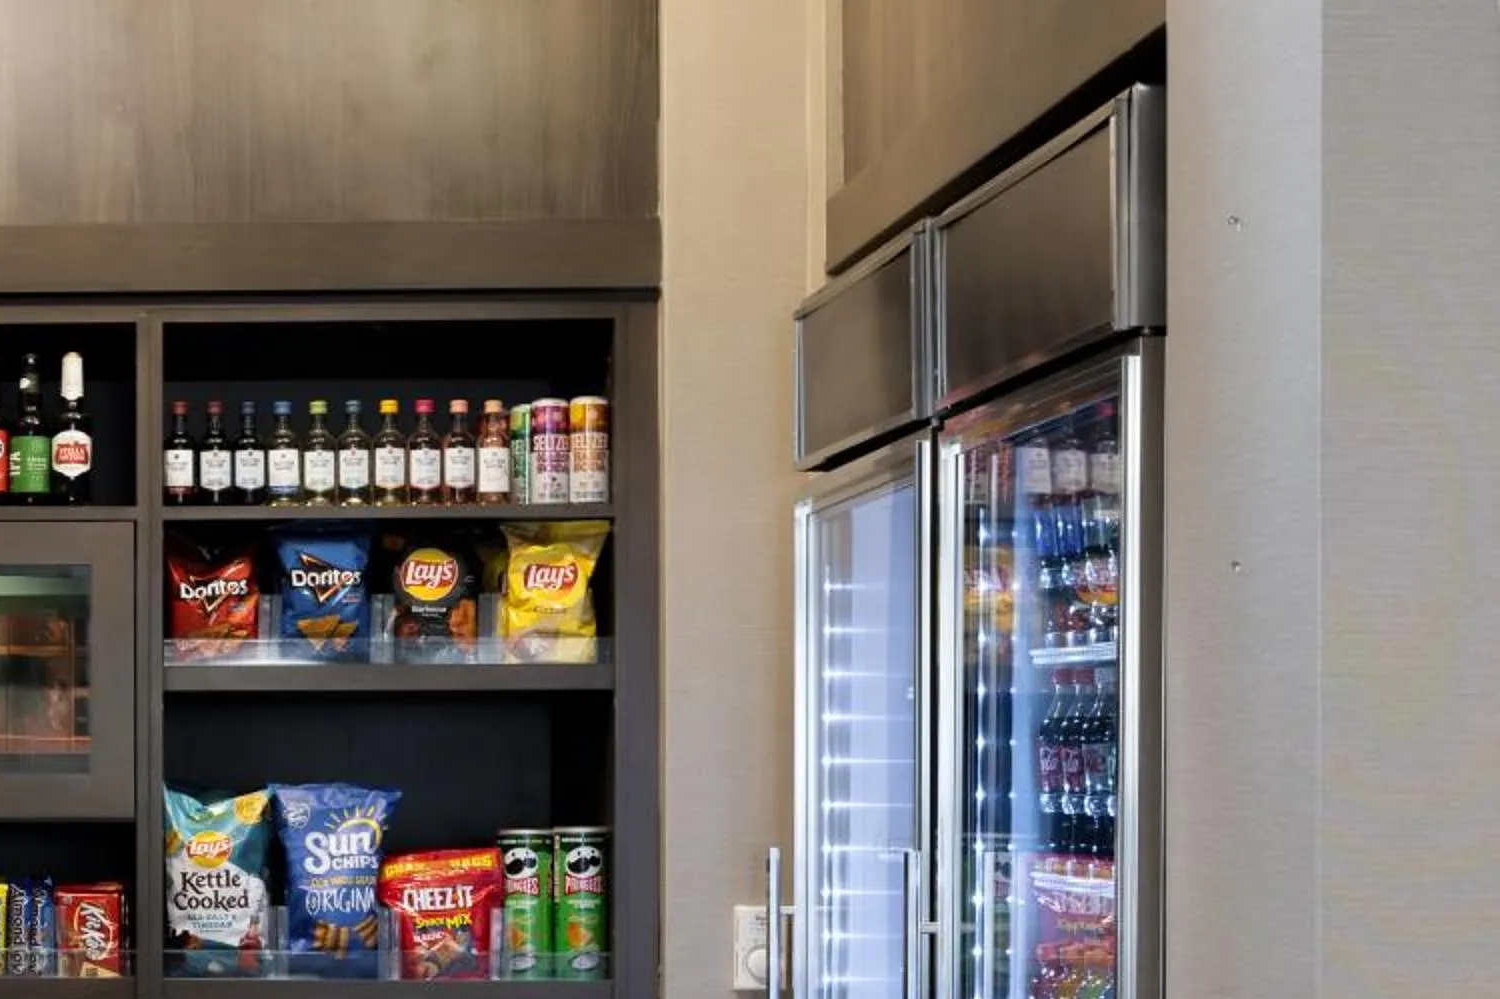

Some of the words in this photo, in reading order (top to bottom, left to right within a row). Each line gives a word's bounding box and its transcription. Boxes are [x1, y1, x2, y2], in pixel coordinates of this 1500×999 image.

[291, 569, 361, 587] Doritos
[405, 560, 455, 588] Lay's
[526, 563, 575, 590] Lay's
[180, 579, 248, 599] Doritos
[190, 839, 231, 858] Lay's
[303, 831, 376, 875] Sun
[331, 856, 378, 870] CHIPS
[181, 871, 242, 894] Kettle
[174, 889, 249, 911] Cooked
[305, 888, 375, 915] ORIGINA
